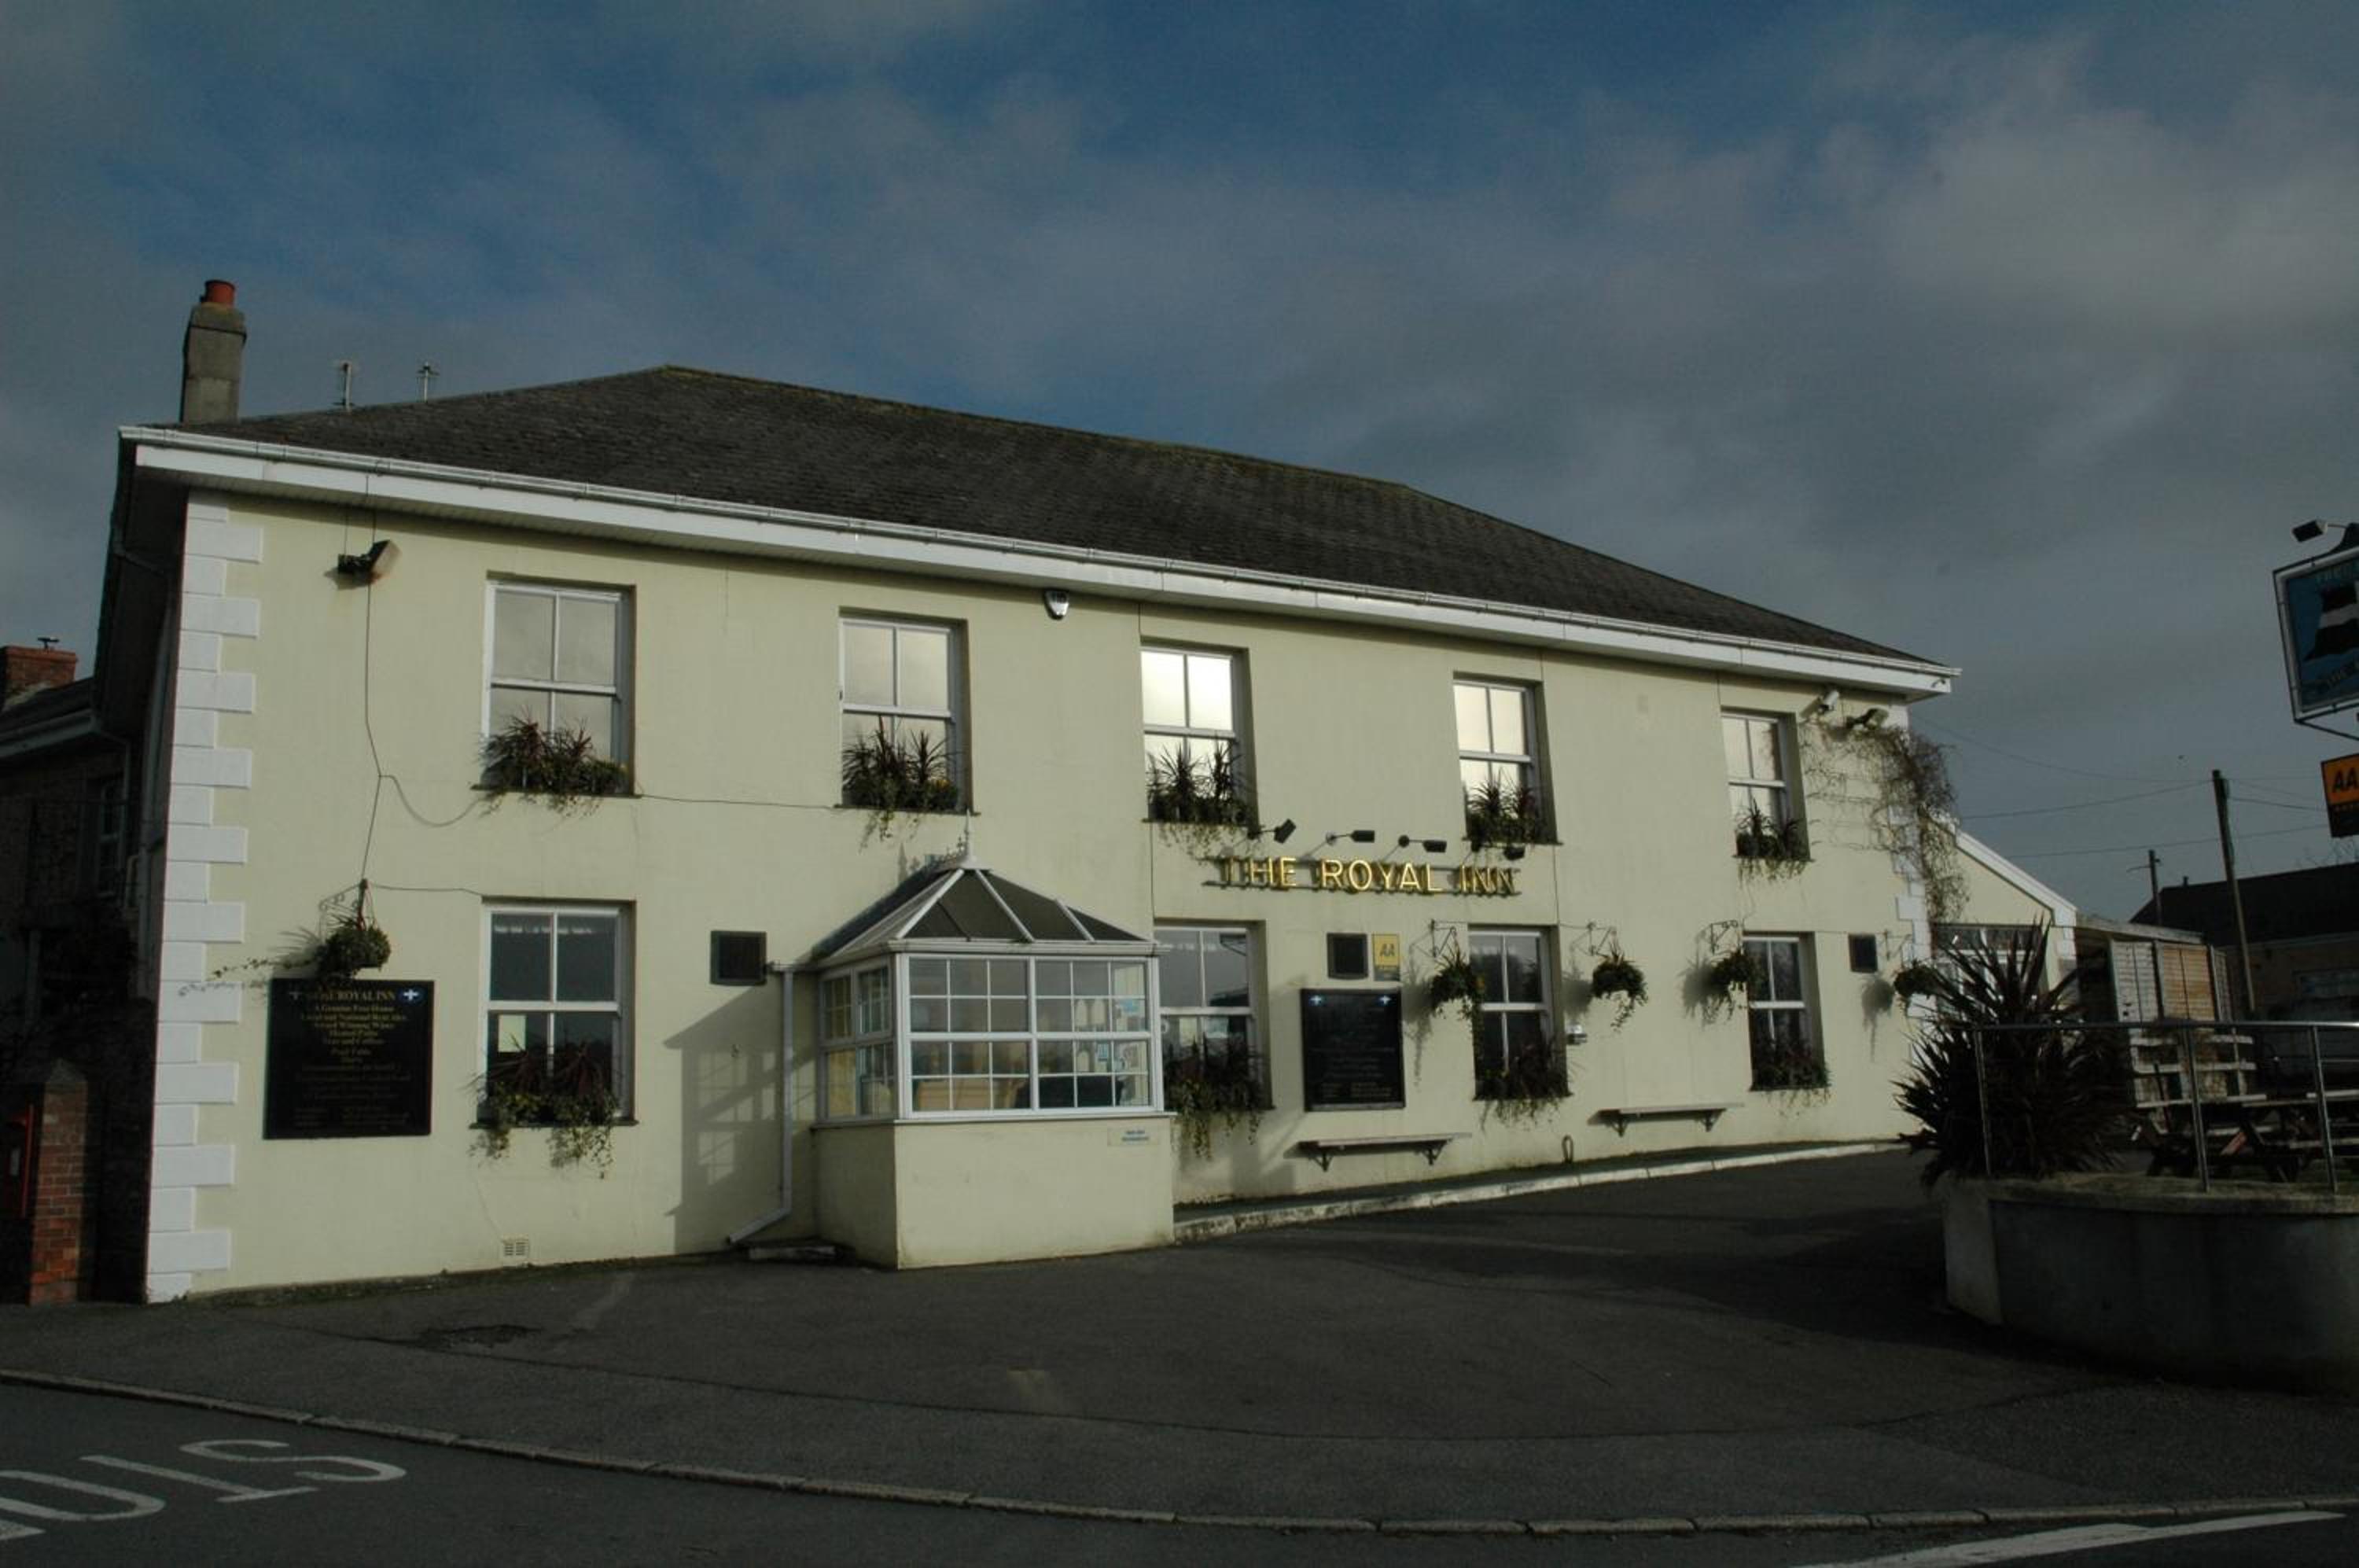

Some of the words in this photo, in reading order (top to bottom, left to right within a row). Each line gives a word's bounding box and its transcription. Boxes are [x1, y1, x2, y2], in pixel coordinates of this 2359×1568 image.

[1224, 856, 1297, 888] THE
[1320, 859, 1443, 893] ROYAL
[1459, 864, 1516, 894] INN
[0, 1438, 407, 1541] STO
